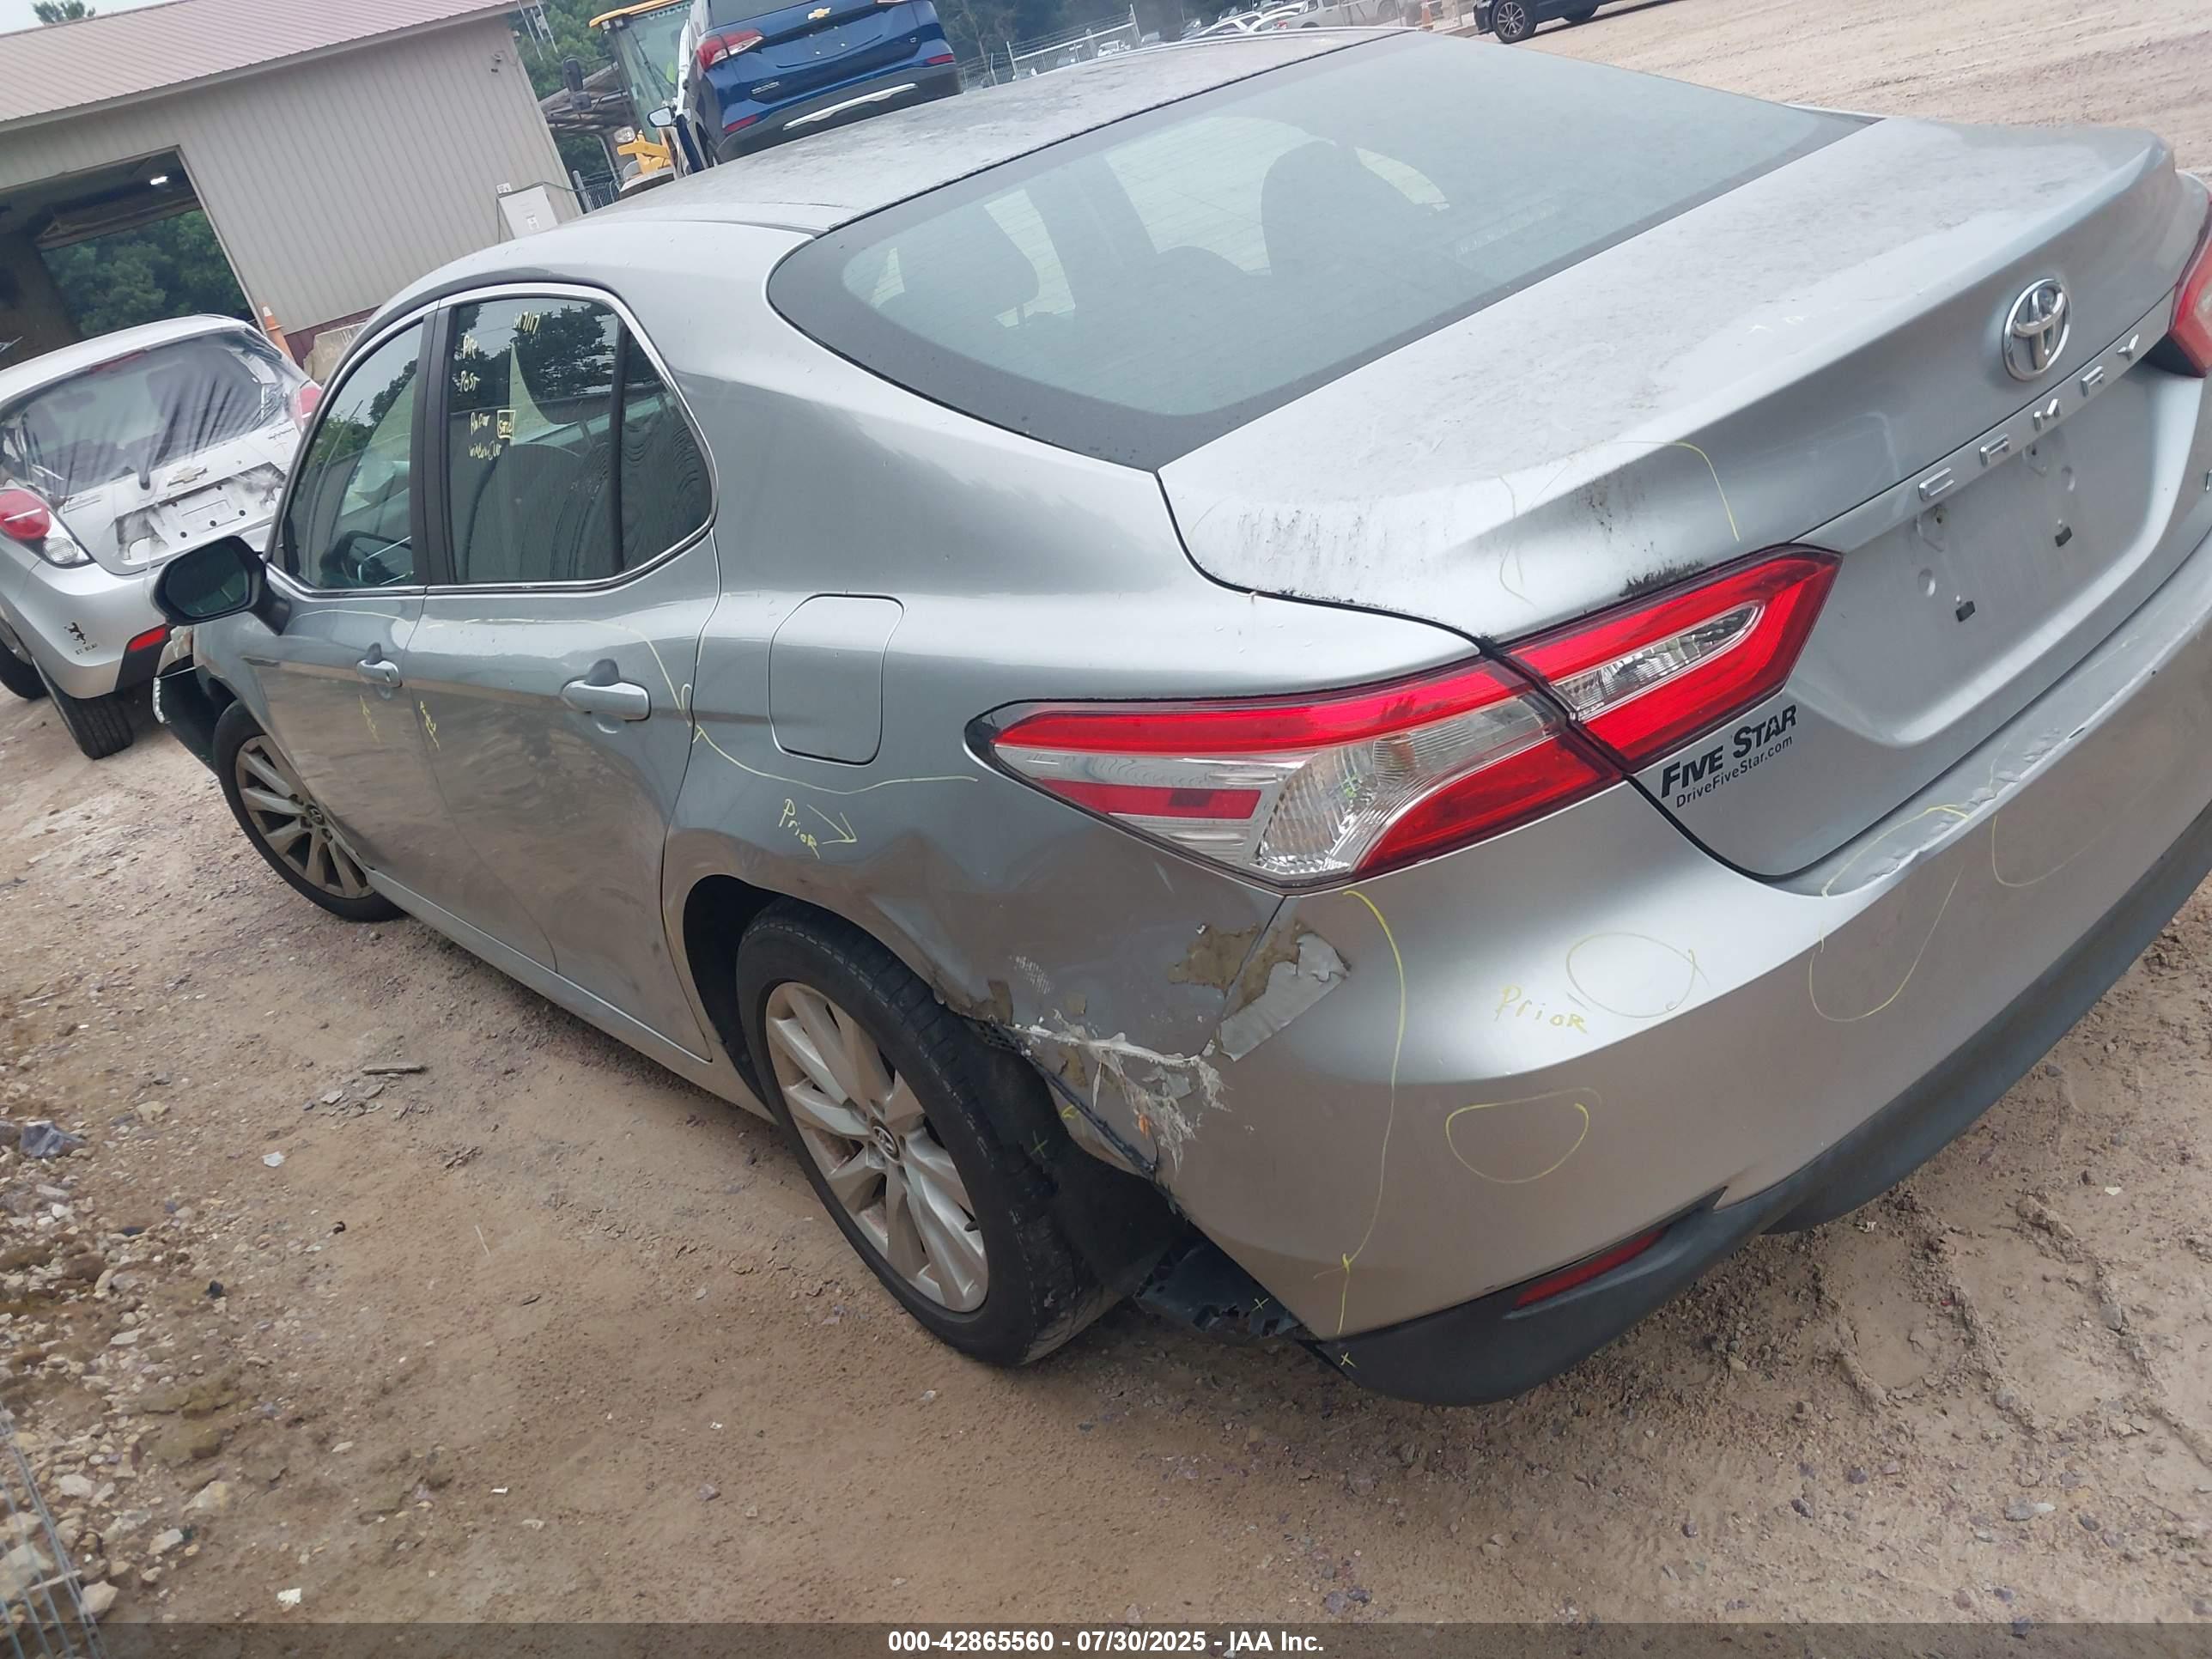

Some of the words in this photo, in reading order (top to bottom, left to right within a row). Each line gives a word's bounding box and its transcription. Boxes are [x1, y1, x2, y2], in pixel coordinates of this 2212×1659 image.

[1917, 333, 2141, 502] CAMRY
[1661, 745, 1724, 799] FIVE
[1732, 704, 1797, 759] STAR
[1676, 735, 1793, 808] DriveFiveStar.com
